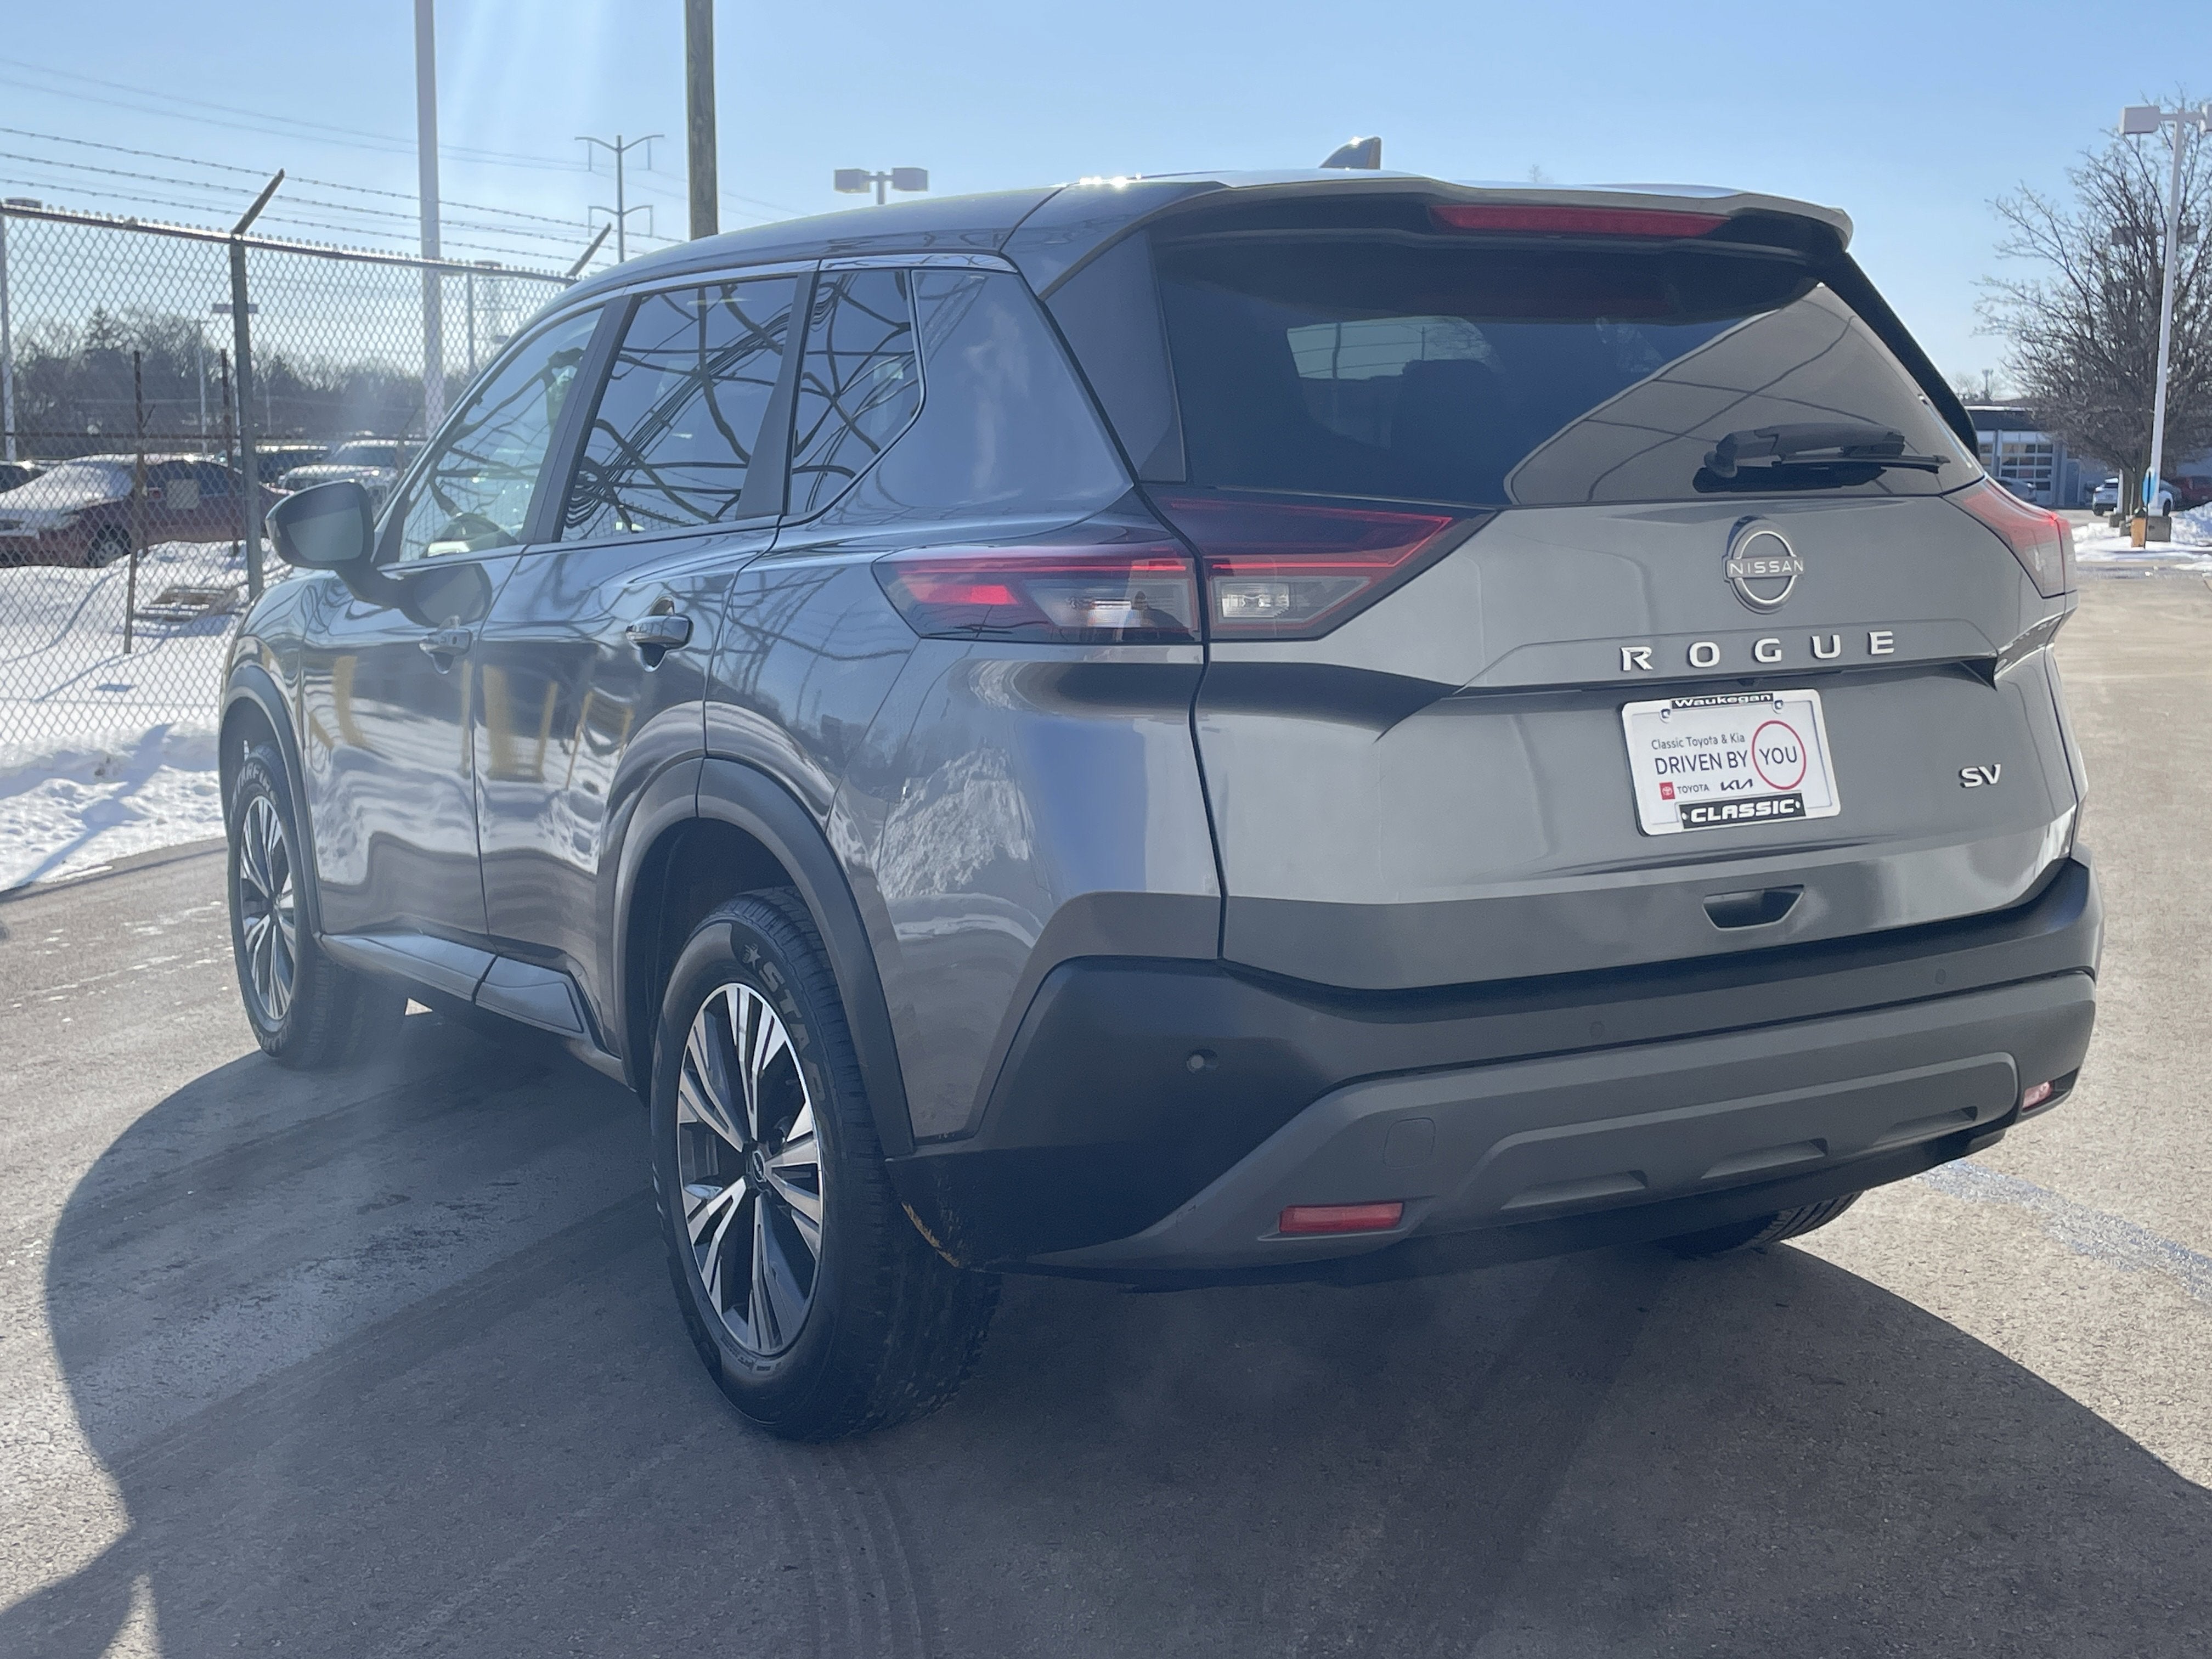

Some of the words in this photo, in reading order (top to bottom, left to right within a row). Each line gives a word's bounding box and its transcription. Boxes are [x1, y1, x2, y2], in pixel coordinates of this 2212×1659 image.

[1730, 560, 1803, 574] NISSAN
[1621, 631, 1895, 671] ROGUE
[1675, 694, 1770, 707] Waukegan
[1651, 739, 1684, 750] Classic
[1686, 736, 1718, 748] Toyota
[1721, 735, 1728, 744] &
[1730, 732, 1745, 743] Kia
[1655, 753, 1722, 775] DRIVEN
[1726, 750, 1748, 769] BY
[1759, 746, 1797, 765] YOU
[1961, 764, 2001, 787] SV
[1677, 784, 1709, 794] TOYOTA
[1720, 778, 1753, 791] KIA
[1690, 799, 1795, 823] CLASSIC
